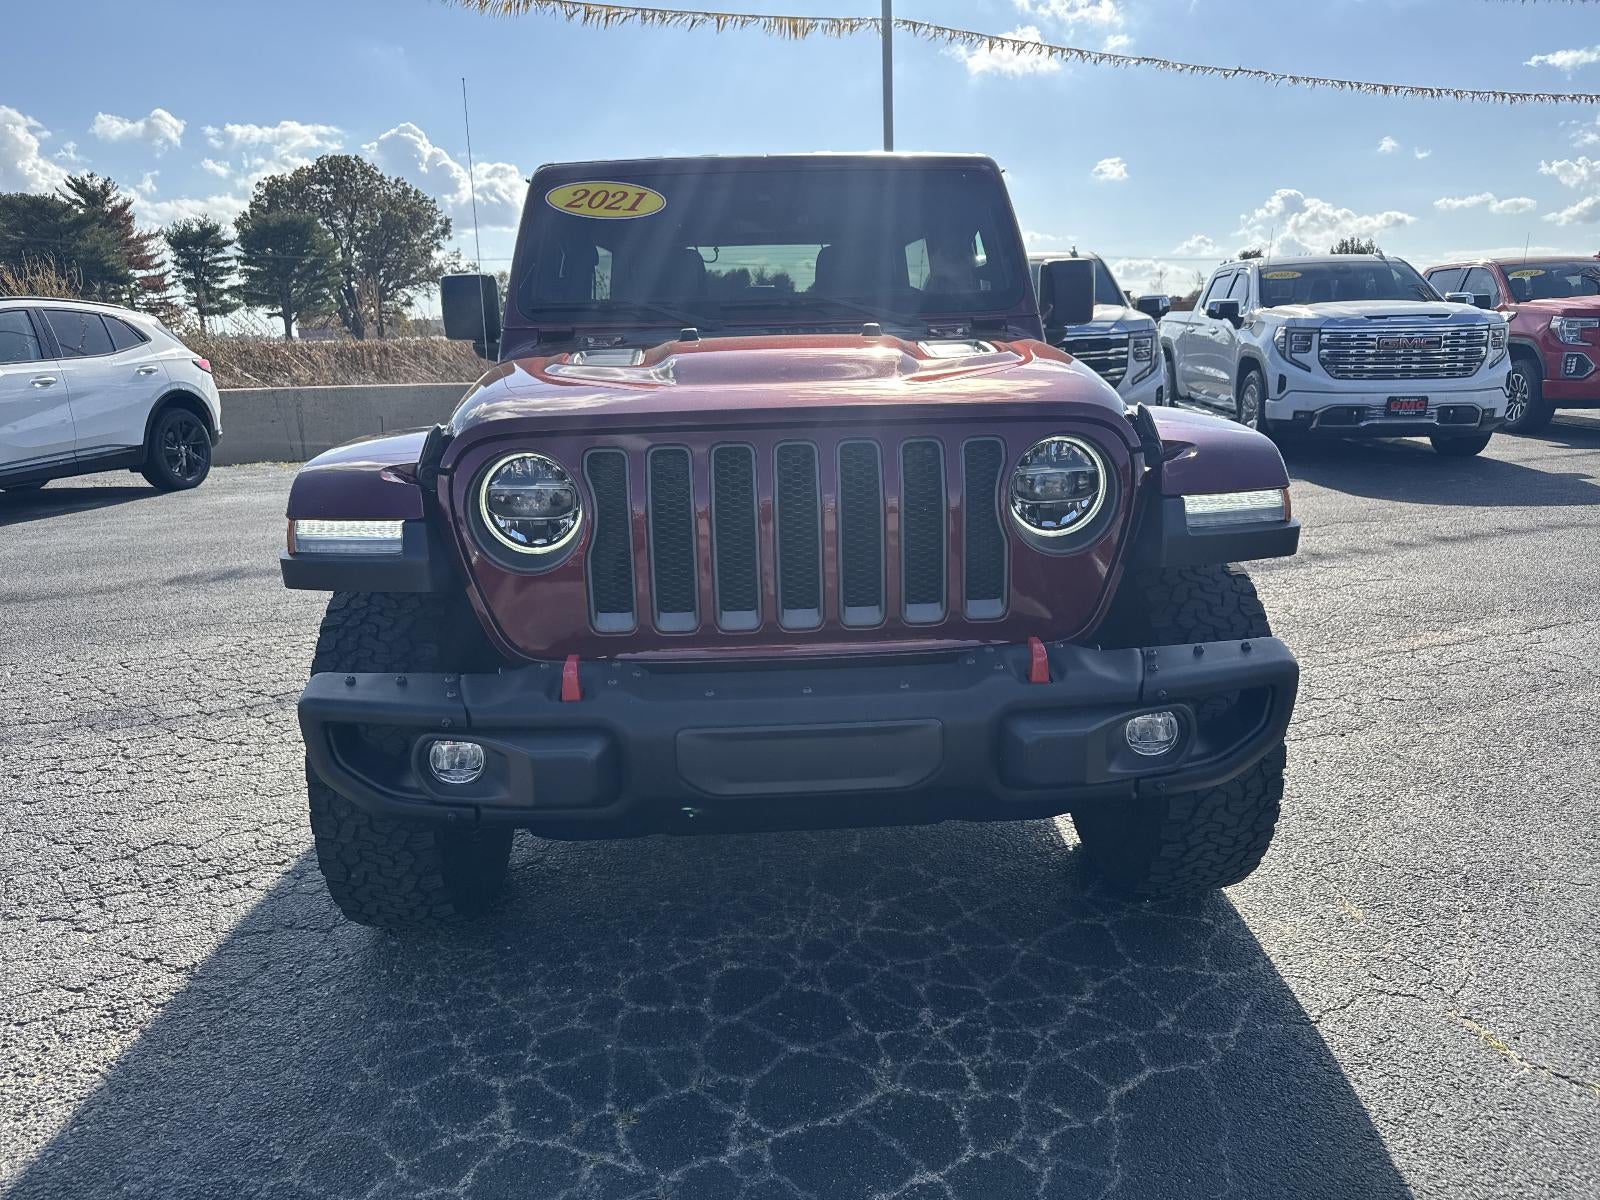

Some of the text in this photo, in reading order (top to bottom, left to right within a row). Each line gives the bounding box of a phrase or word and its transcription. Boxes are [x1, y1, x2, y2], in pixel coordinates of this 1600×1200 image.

[564, 188, 648, 212] 2021
[1380, 337, 1440, 349] GMC
[1391, 401, 1426, 409] GMC
